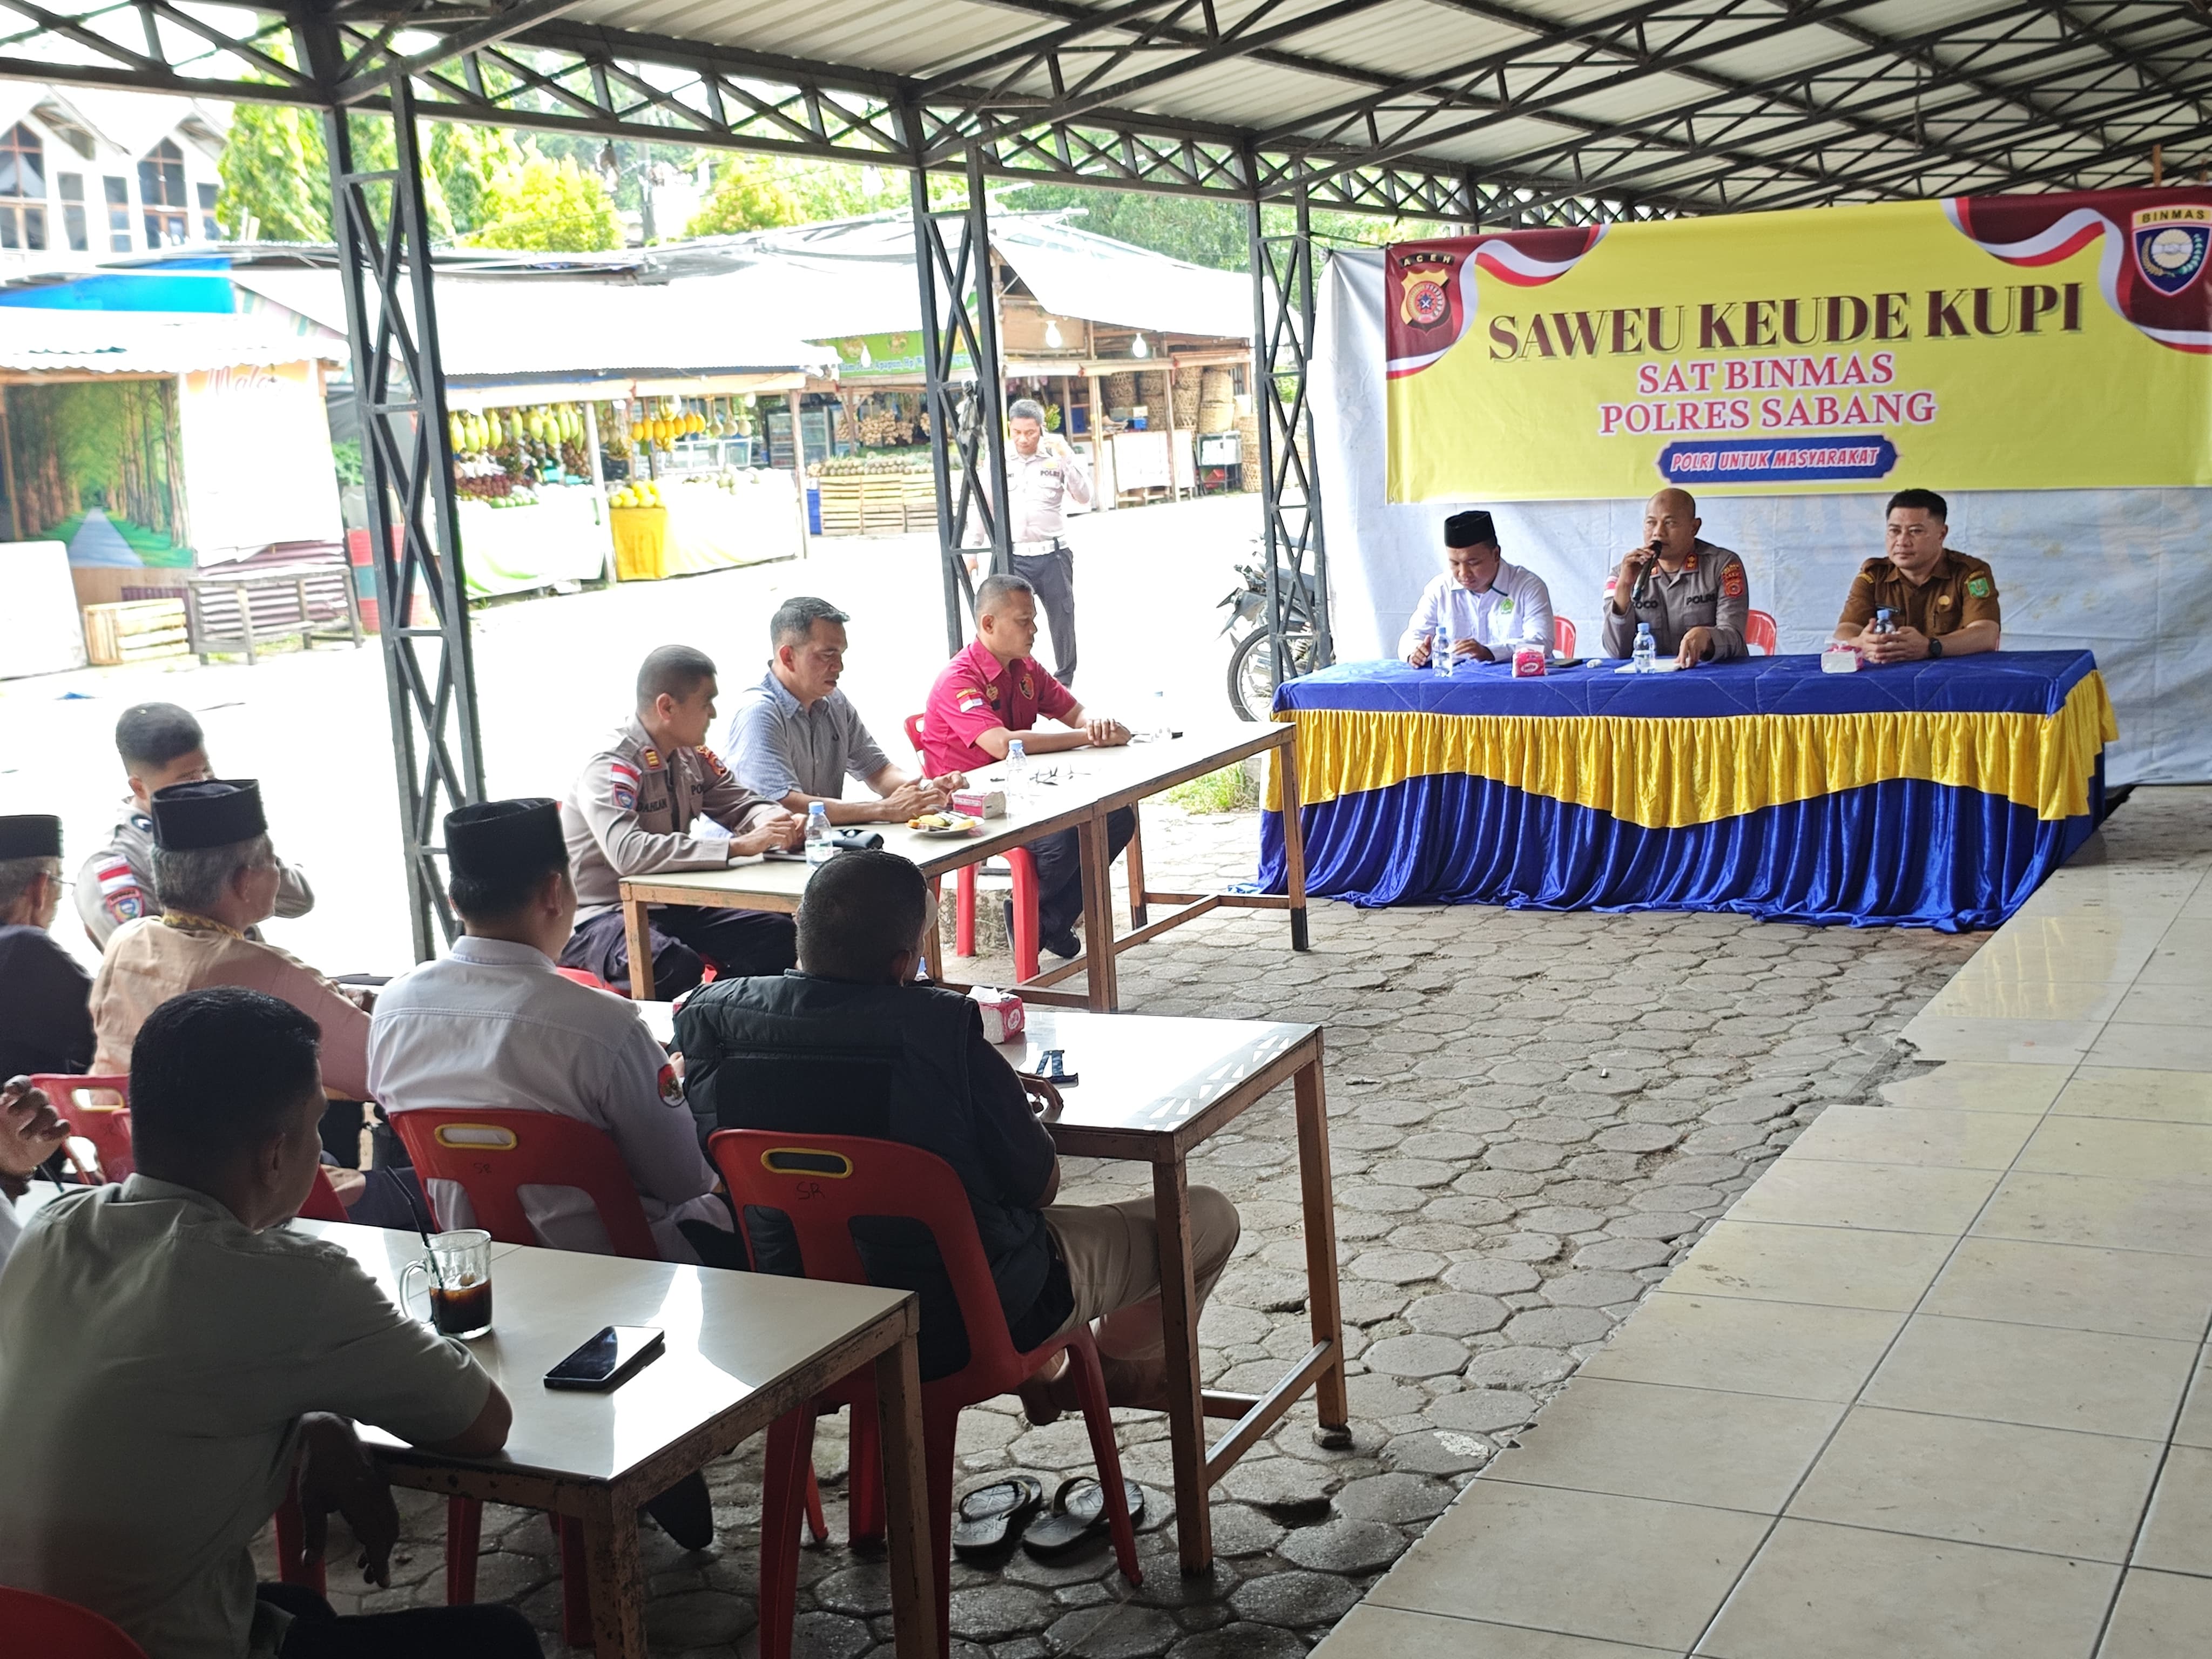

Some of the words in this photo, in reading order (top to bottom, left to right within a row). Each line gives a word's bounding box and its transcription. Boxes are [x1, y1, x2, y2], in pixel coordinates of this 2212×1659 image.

[2142, 210, 2205, 223] BINMAS
[1404, 254, 1451, 266] ACEH
[1489, 305, 1684, 361] SAWEU
[1697, 292, 1910, 350] KEUDE
[1925, 282, 2083, 338] KUPI
[1638, 362, 1715, 395] SAT
[1724, 353, 1894, 391] BINMAS
[1600, 399, 1750, 434] POLRES
[1762, 392, 1936, 428] SABANG
[1671, 453, 1716, 472] POLRI
[1718, 450, 1772, 470] UNTUK
[1771, 447, 1880, 469] MASYARAKAT
[796, 1181, 826, 1200] SR
